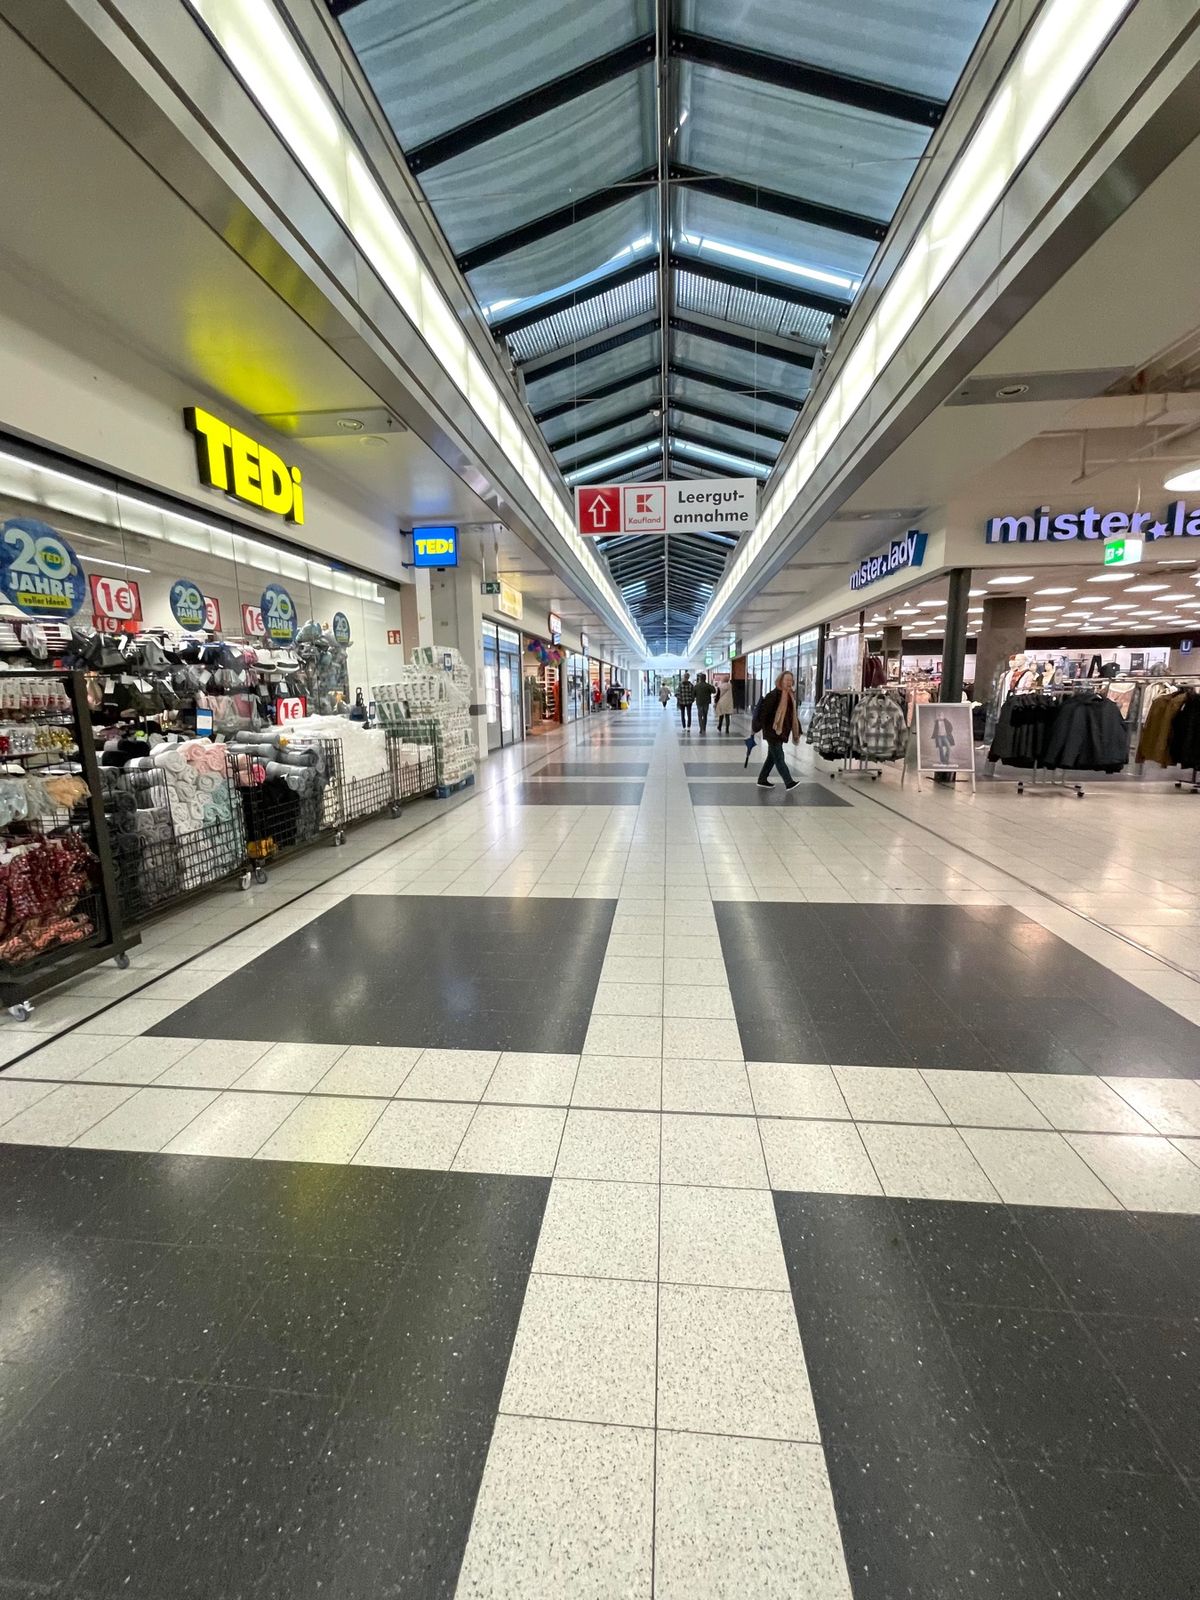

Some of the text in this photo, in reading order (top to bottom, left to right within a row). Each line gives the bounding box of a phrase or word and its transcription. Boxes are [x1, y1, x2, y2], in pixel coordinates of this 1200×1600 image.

[194, 405, 305, 525] TEDi
[678, 490, 745, 506] Leergut-
[628, 516, 661, 525] Kaufland
[673, 509, 749, 524] annahme
[4, 528, 72, 580] 20
[415, 538, 454, 555] TEDi
[9, 571, 75, 599] JAHRE
[101, 582, 132, 613] 1€
[174, 585, 201, 610] 20
[266, 590, 292, 620] 20
[267, 616, 294, 631] JAHRE
[283, 702, 300, 720] 1€
